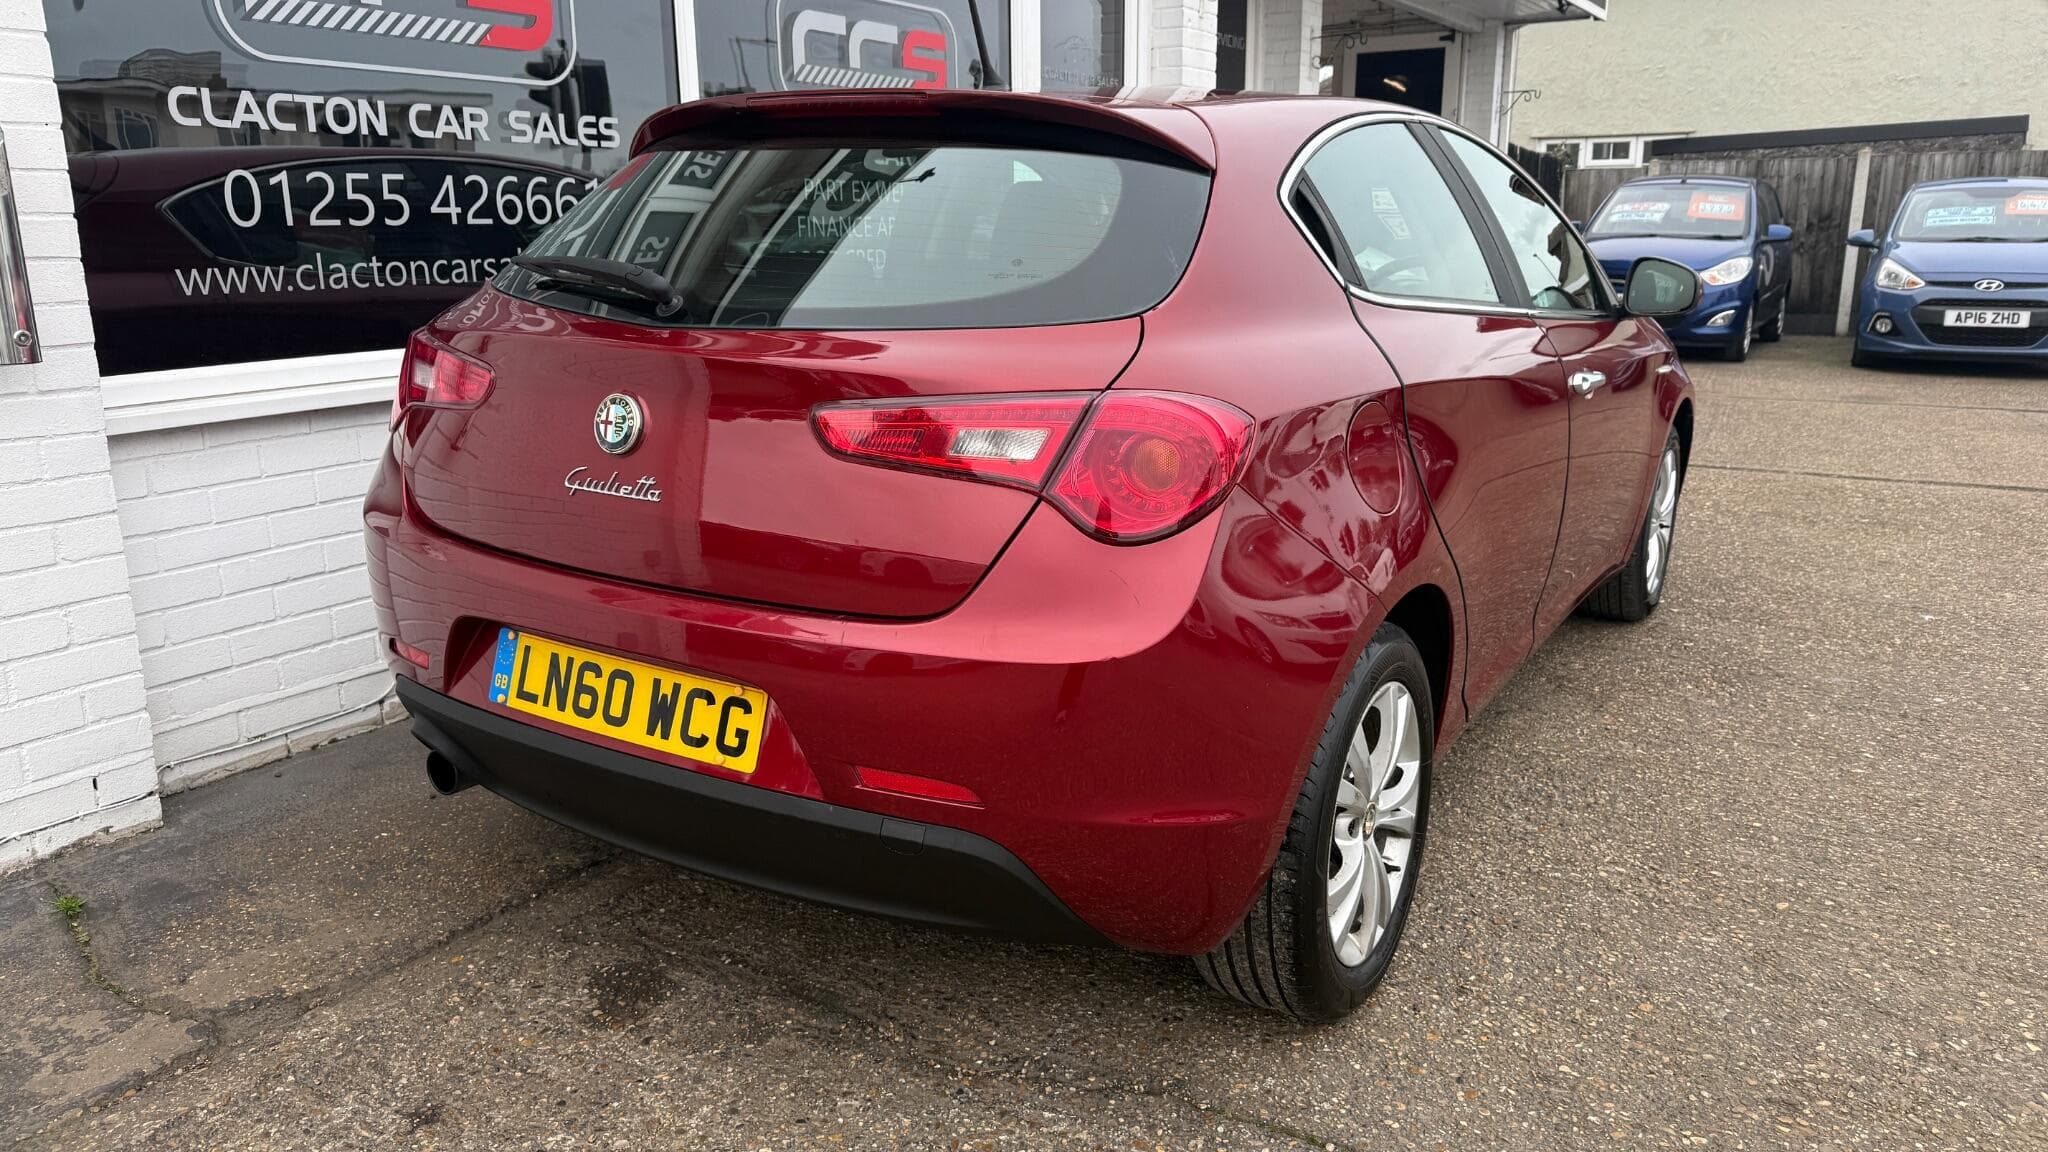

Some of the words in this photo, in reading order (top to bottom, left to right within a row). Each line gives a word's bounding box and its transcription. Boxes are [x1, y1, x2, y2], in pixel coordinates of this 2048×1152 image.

[167, 85, 389, 137] CLACTON
[408, 103, 491, 142] CAR
[508, 110, 621, 148] SALES
[223, 168, 411, 228] 01255
[430, 174, 600, 225] 42666
[803, 178, 846, 202] PART
[851, 180, 872, 202] EX
[797, 215, 874, 238] FINANCE
[1954, 311, 1988, 325] AP16
[1990, 312, 2021, 325] ZHD
[564, 466, 663, 502] Giulietta
[494, 672, 509, 690] GB
[515, 644, 635, 728] LN60
[645, 677, 753, 758] WCG
